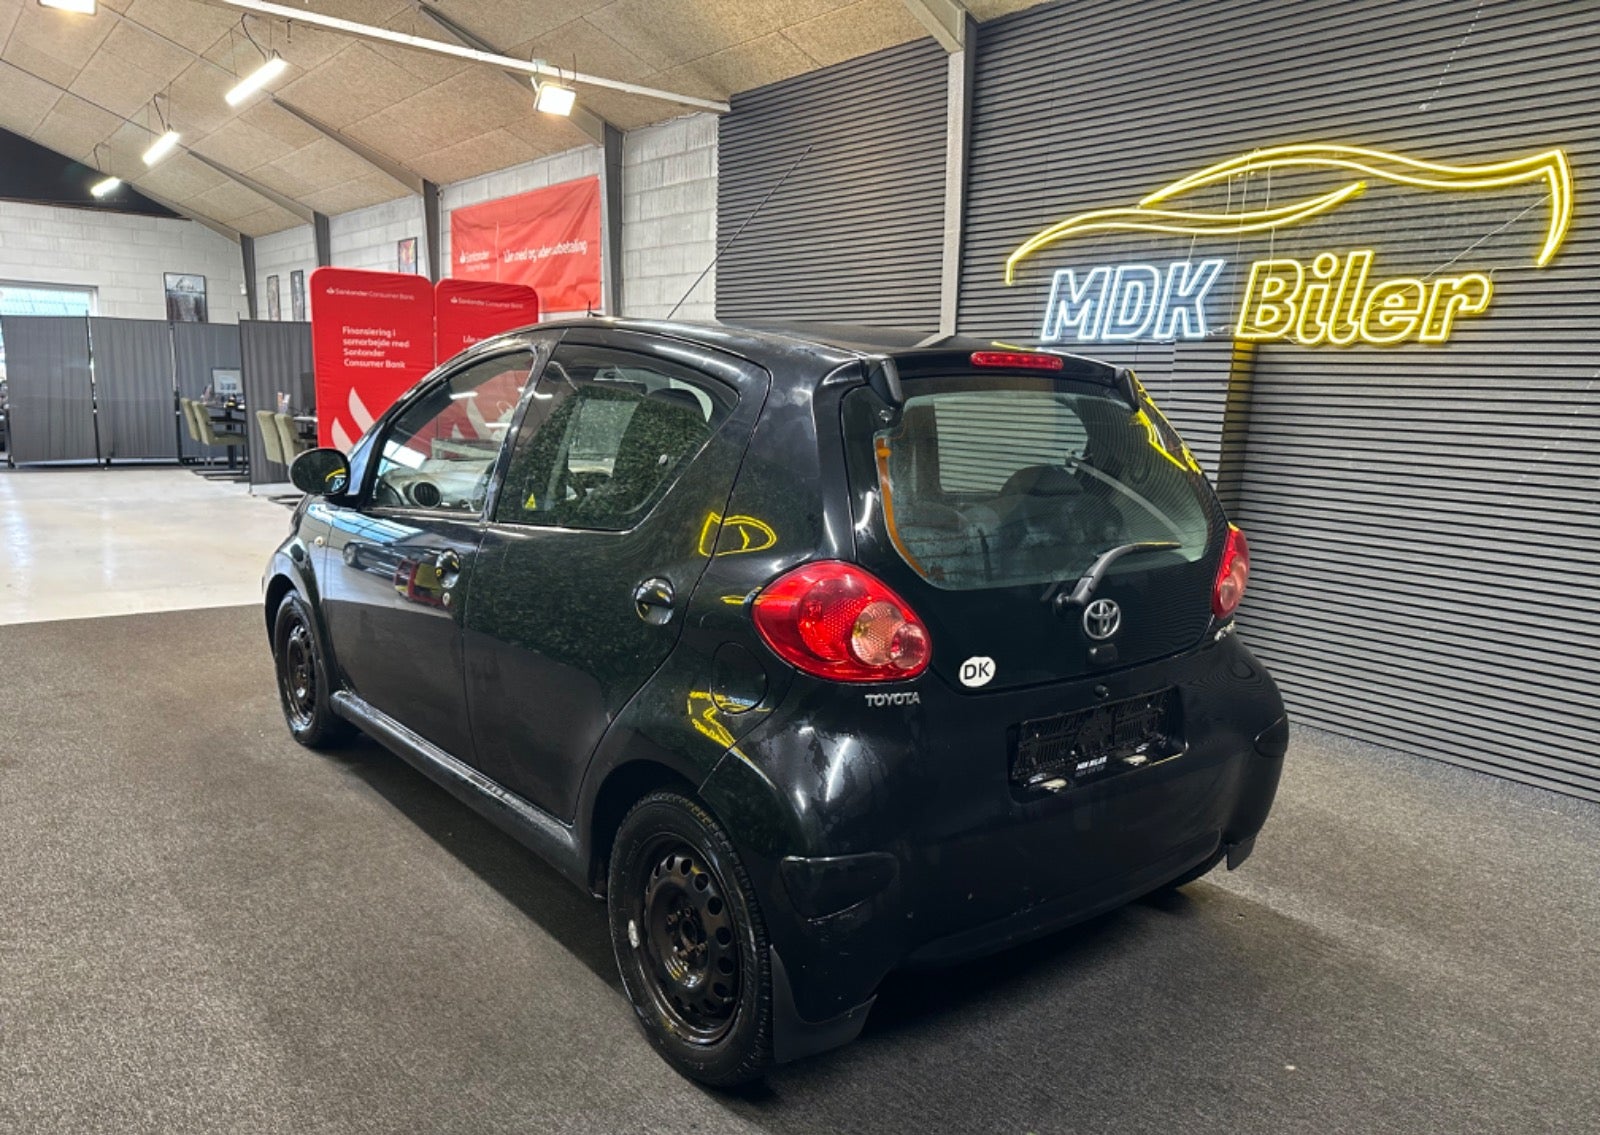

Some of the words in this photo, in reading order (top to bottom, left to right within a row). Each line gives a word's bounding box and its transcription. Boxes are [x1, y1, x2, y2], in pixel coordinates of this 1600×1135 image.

[335, 288, 368, 297] Santander
[368, 291, 399, 299] Consumer
[1039, 258, 1225, 342] MDK
[1234, 249, 1493, 345] Biler
[342, 325, 392, 338] Finansiering
[343, 337, 391, 348] samarbejde
[391, 340, 410, 348] med
[343, 348, 385, 357] Santander
[343, 358, 385, 368] Consumer
[385, 359, 406, 368] Bank
[963, 661, 991, 680] DK
[864, 691, 921, 707] TOYOTA
